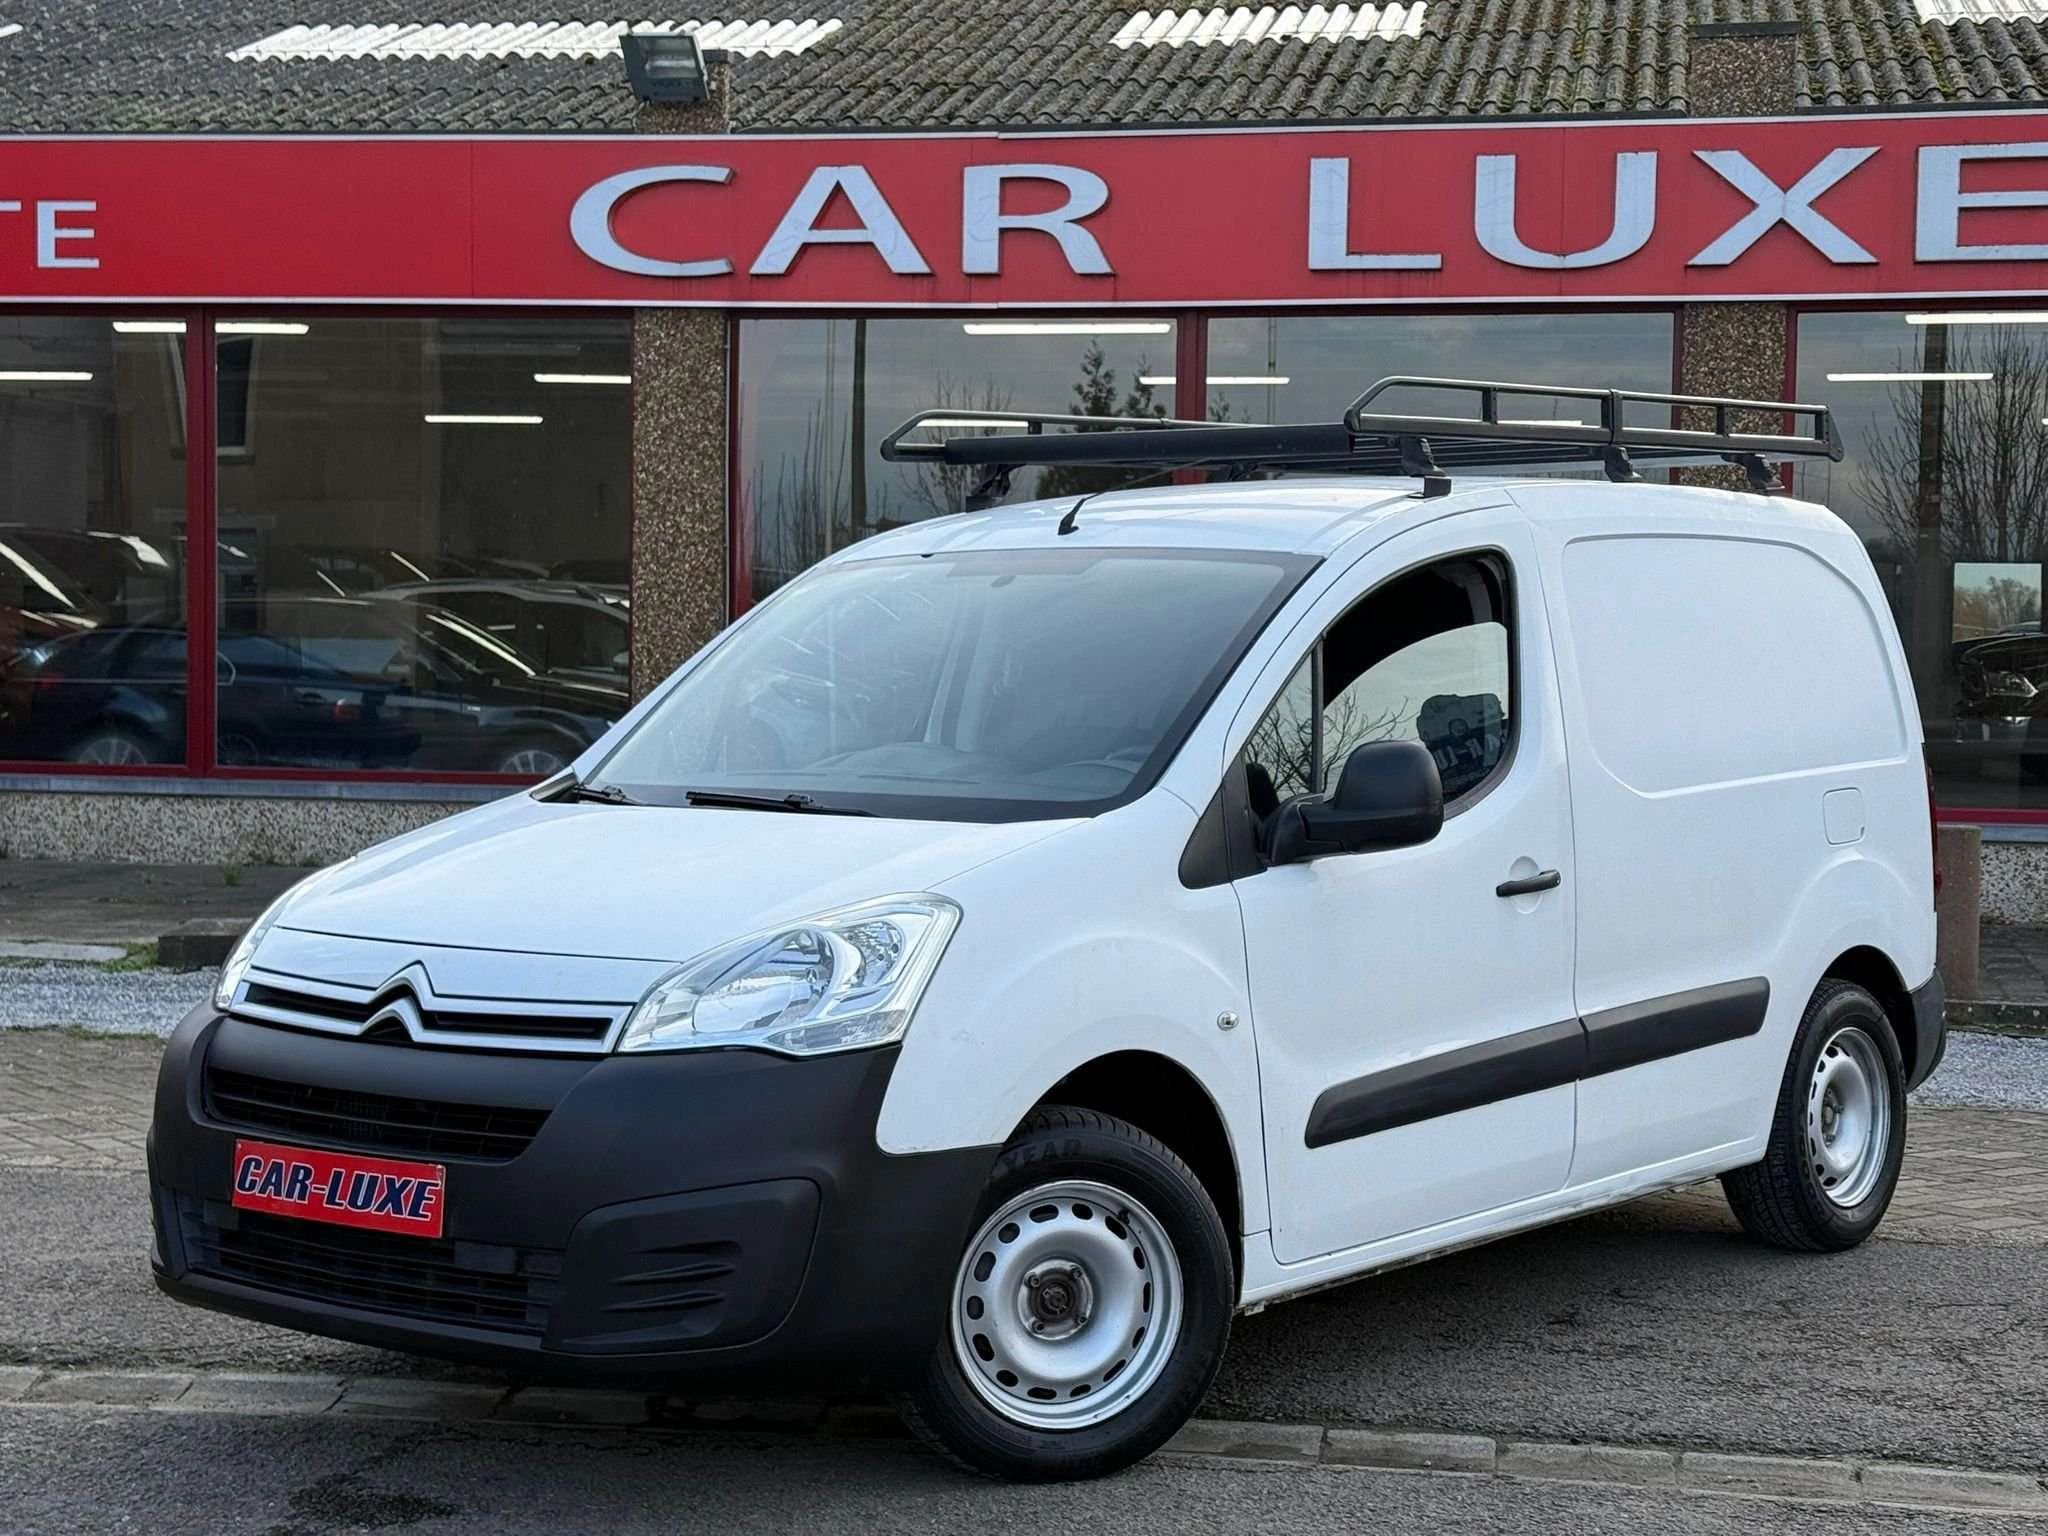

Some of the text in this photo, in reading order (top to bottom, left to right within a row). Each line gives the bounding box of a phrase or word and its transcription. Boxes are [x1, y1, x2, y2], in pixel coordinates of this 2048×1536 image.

[569, 142, 2048, 277] CAR LUXE
[234, 1155, 442, 1222] CAR-LUXE
